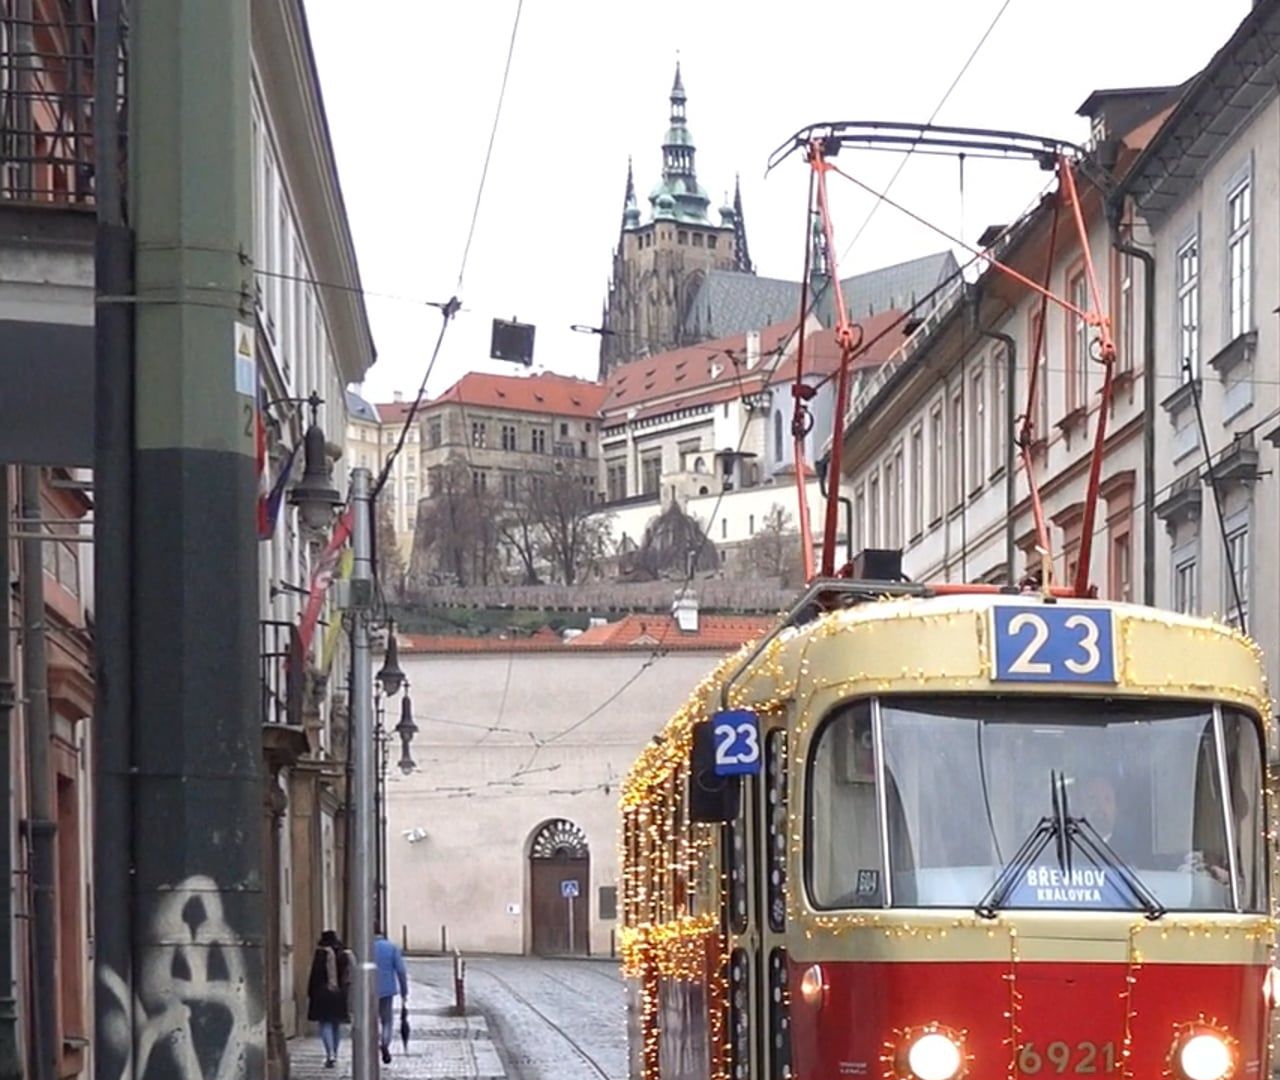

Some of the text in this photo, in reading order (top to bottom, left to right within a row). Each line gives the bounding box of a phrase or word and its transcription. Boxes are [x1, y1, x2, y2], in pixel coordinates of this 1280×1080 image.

[1008, 612, 1100, 674] 23
[714, 723, 759, 765] 23
[1019, 1041, 1115, 1074] 6921
